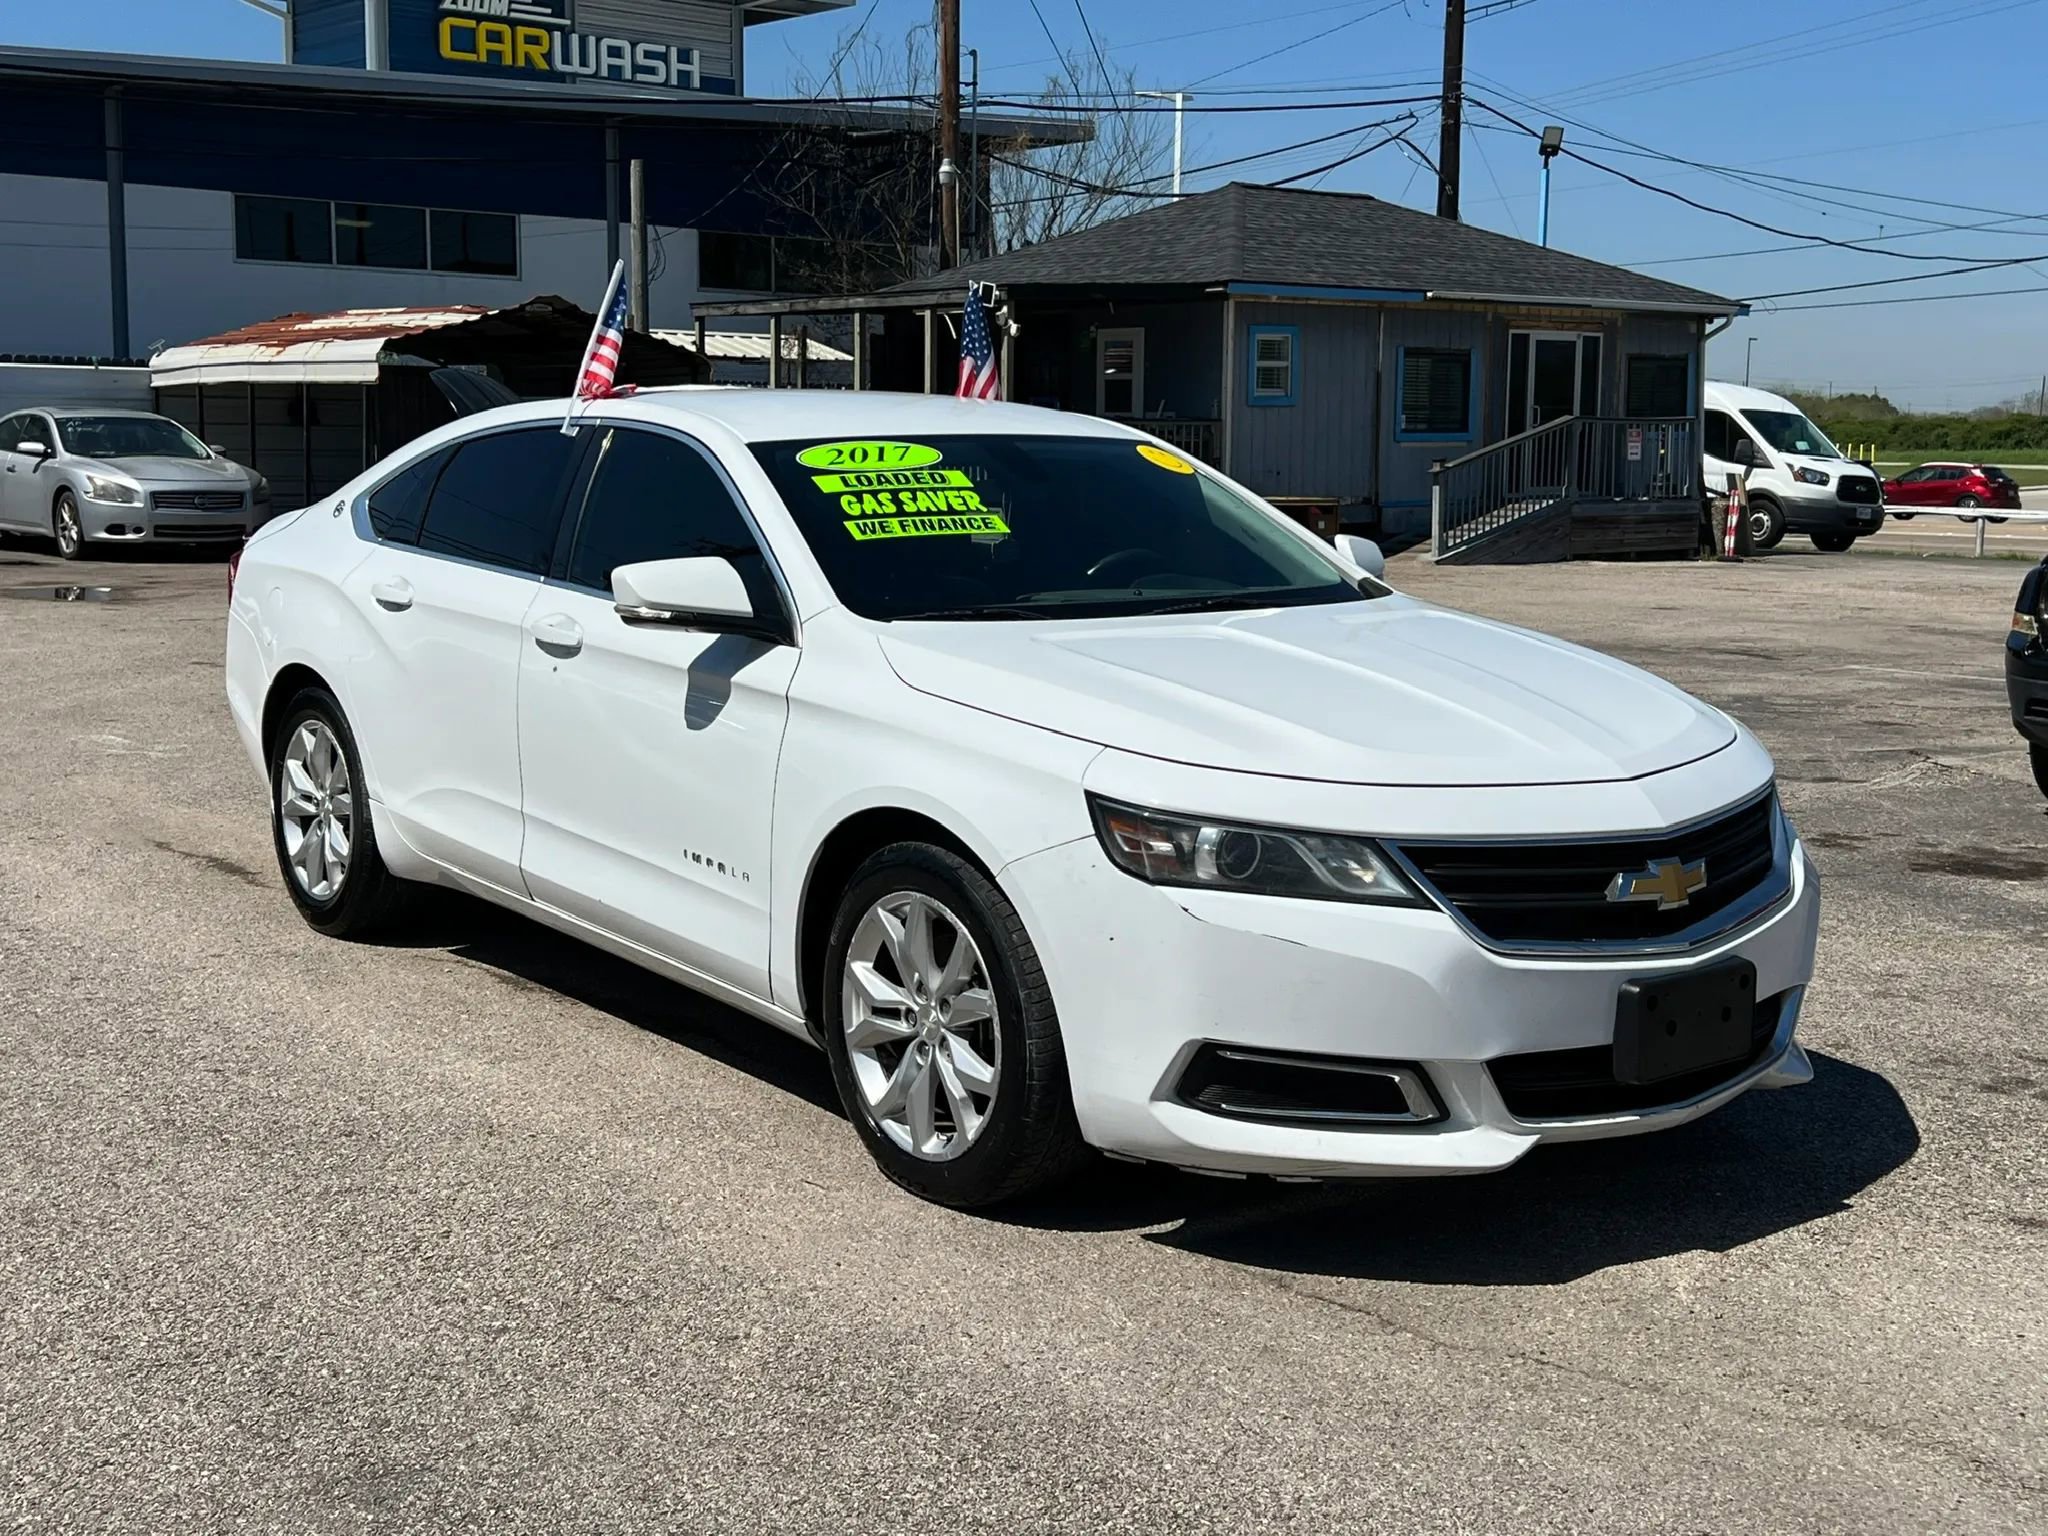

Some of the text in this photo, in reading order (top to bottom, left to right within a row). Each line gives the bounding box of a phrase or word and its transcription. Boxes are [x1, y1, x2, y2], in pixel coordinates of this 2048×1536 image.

[826, 445, 911, 466] 2017
[839, 471, 949, 489] LOADED
[840, 490, 988, 516] GAS SAVER
[854, 516, 998, 536] WE FINANCE
[683, 848, 750, 882] IMPALA
